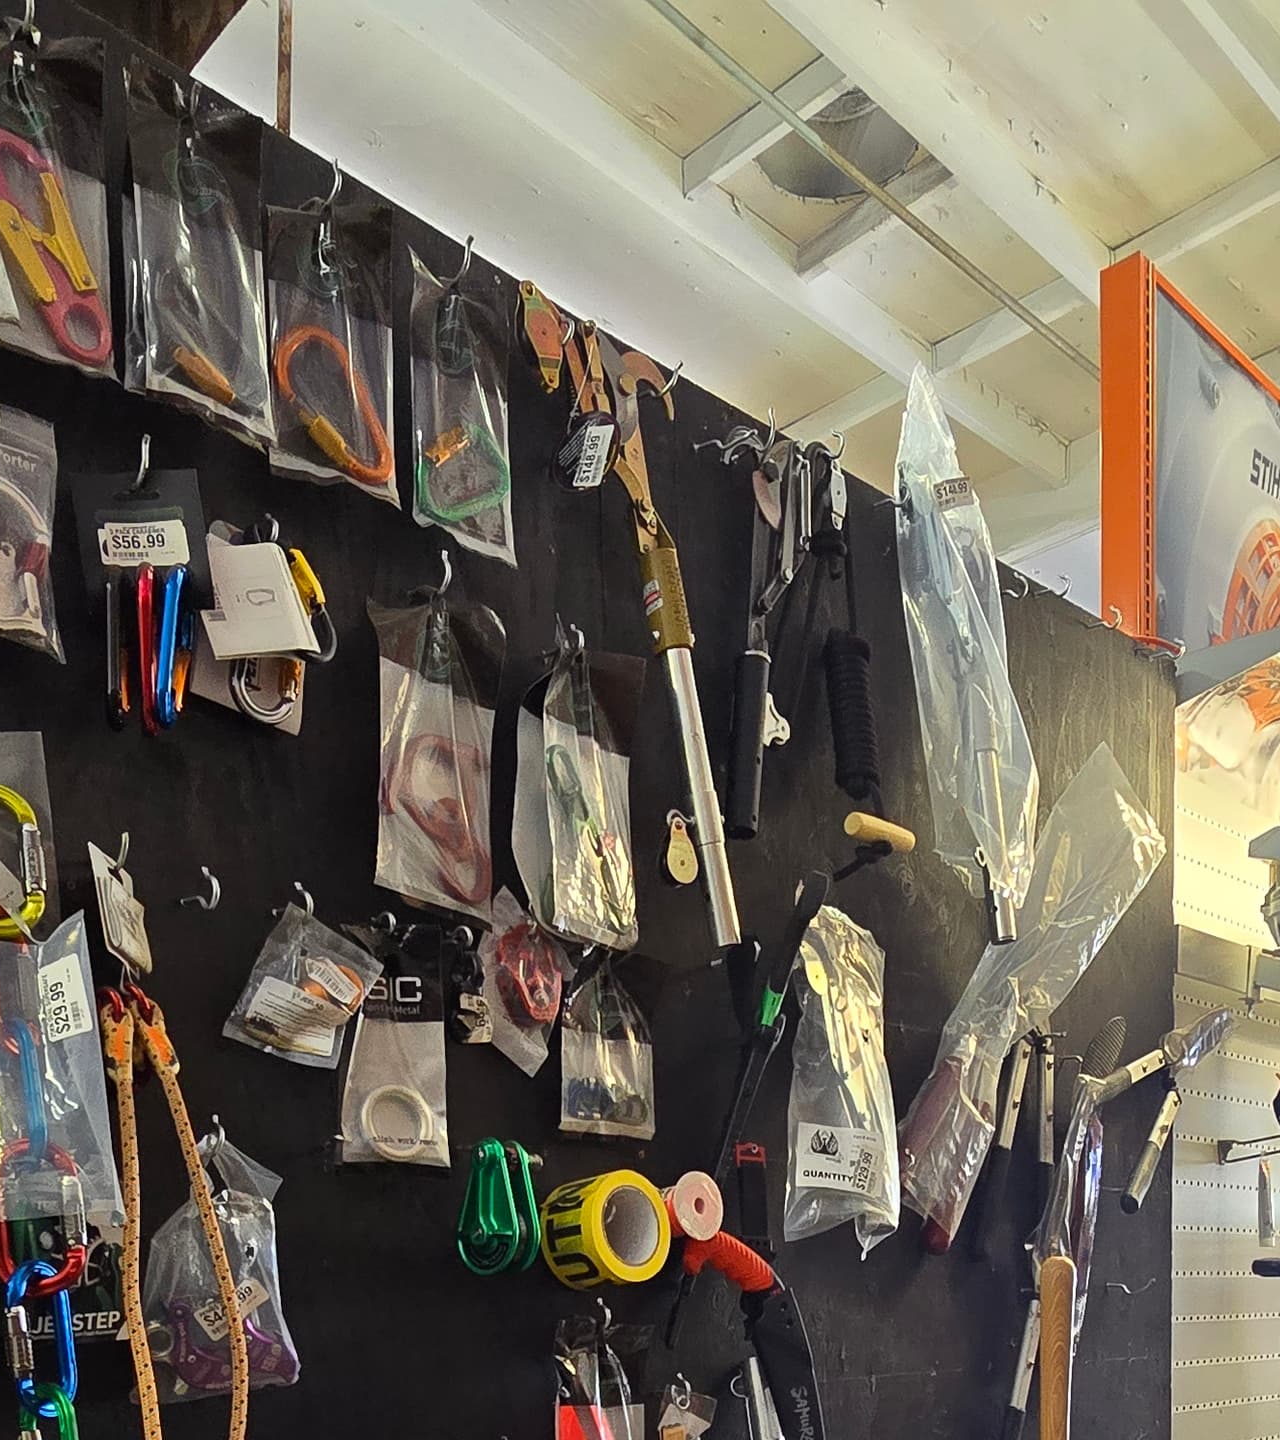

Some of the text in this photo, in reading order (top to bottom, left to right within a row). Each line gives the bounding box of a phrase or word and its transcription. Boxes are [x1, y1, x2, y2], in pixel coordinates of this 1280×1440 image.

[579, 435, 600, 483] $148.99
[111, 533, 166, 550] $56.99
[49, 980, 70, 1034] $29.99
[802, 1169, 854, 1183] QUANTITY
[855, 1151, 874, 1191] $129.99
[29, 1309, 121, 1335] JESTEP
